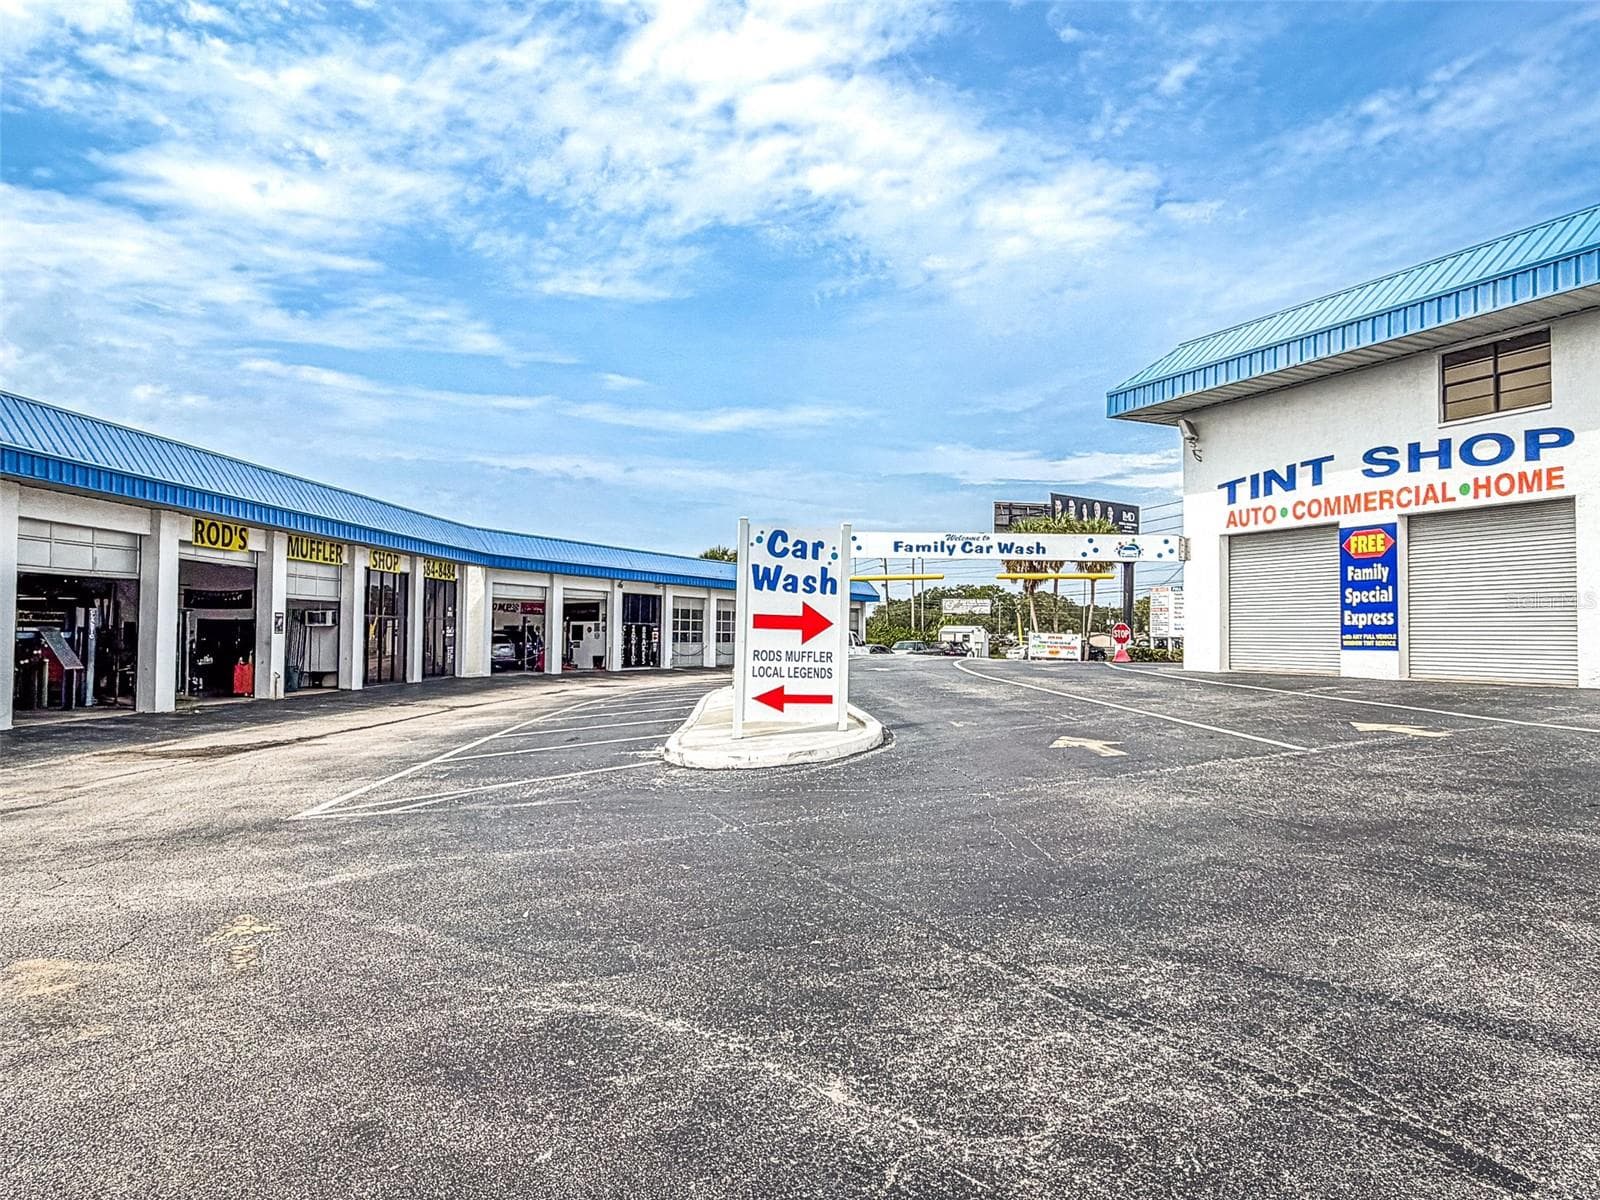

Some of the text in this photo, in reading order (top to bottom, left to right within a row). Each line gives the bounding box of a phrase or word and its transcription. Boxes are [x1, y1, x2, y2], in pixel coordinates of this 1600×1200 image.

[1217, 427, 1575, 505] TINT SHOP
[1226, 466, 1565, 528] AUTO COMMERCIAL HOME
[193, 519, 400, 572] ROD'S MUFFLER SHOP
[767, 529, 825, 561] Car
[945, 533, 980, 542] Welcome
[1350, 532, 1386, 554] FREE
[893, 541, 1047, 556] Family Car Wash
[752, 564, 838, 595] Wash
[1347, 563, 1390, 583] Family
[1344, 585, 1393, 606] Special
[1343, 610, 1395, 629] Express
[1113, 629, 1129, 639] STOP
[753, 650, 833, 663] RODS MUFFLER
[752, 666, 833, 679] LOCAL LEGENDS
